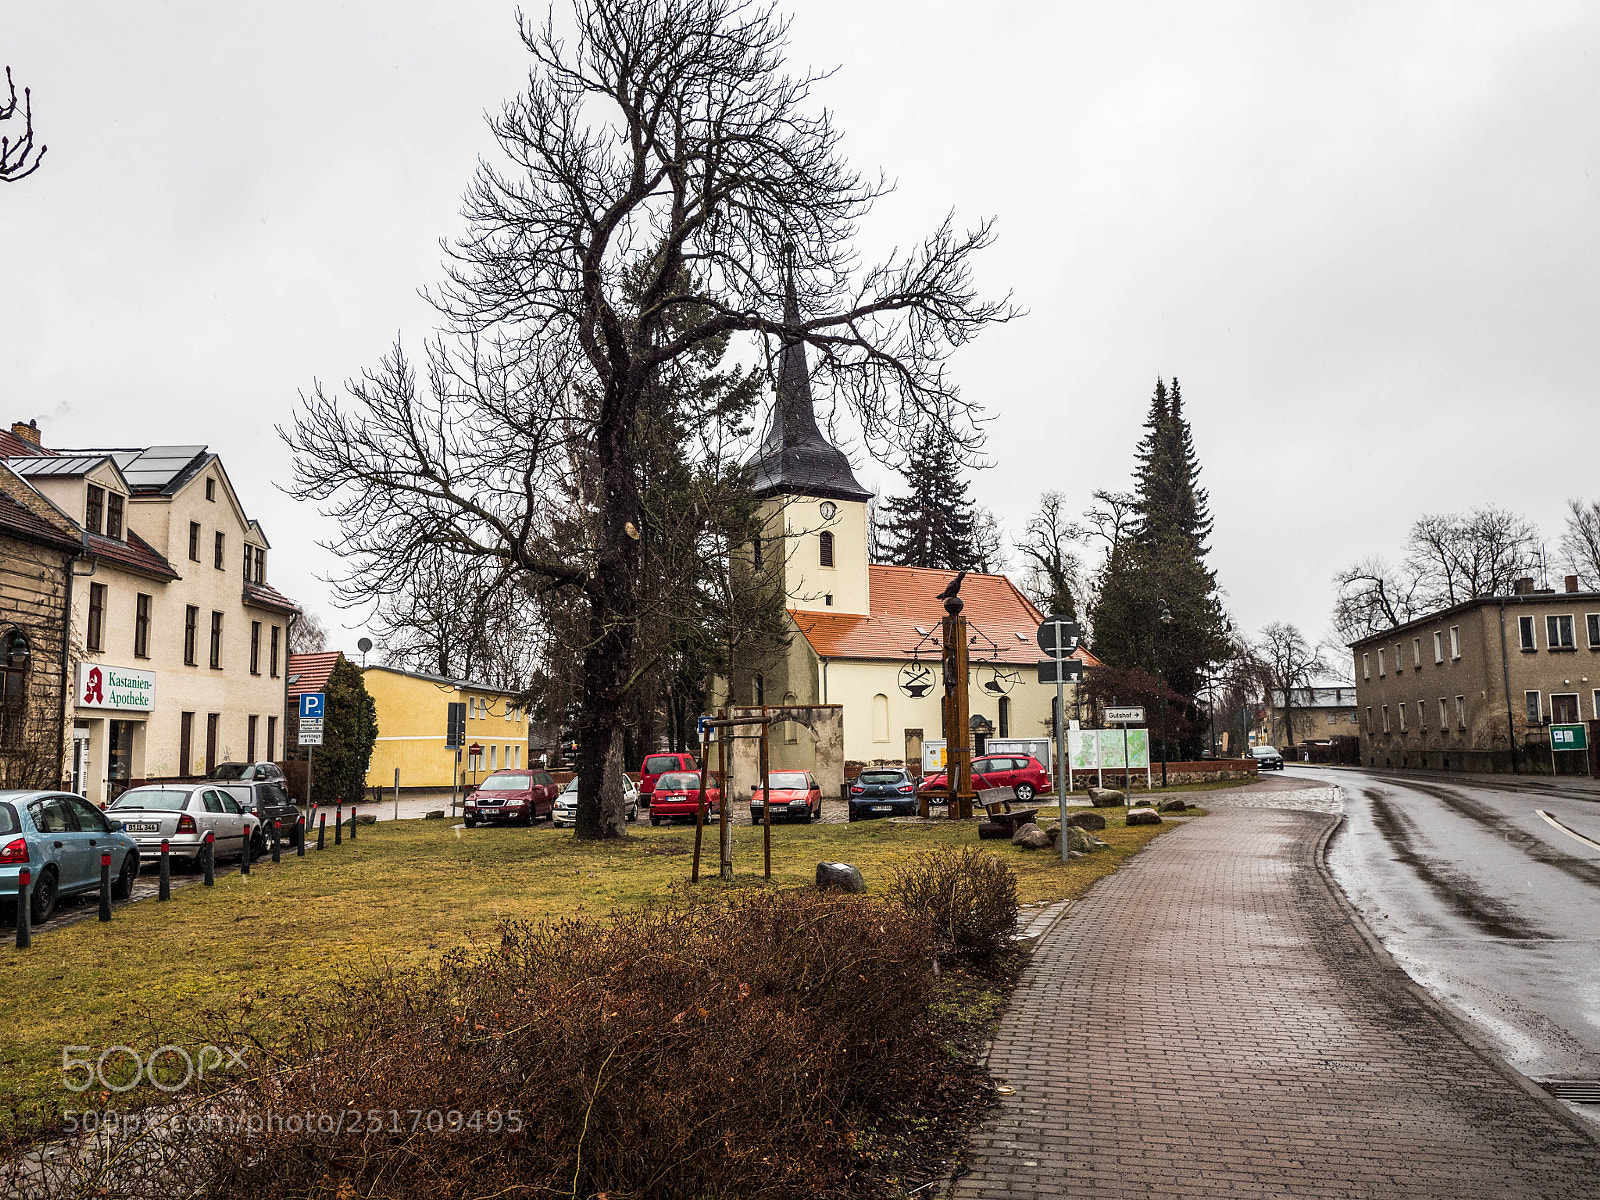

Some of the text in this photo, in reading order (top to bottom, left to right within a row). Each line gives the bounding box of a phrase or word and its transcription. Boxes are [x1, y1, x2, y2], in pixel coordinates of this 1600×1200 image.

[108, 671, 152, 690] Kastanien-
[108, 689, 149, 708] Apotheke
[305, 696, 319, 715] P
